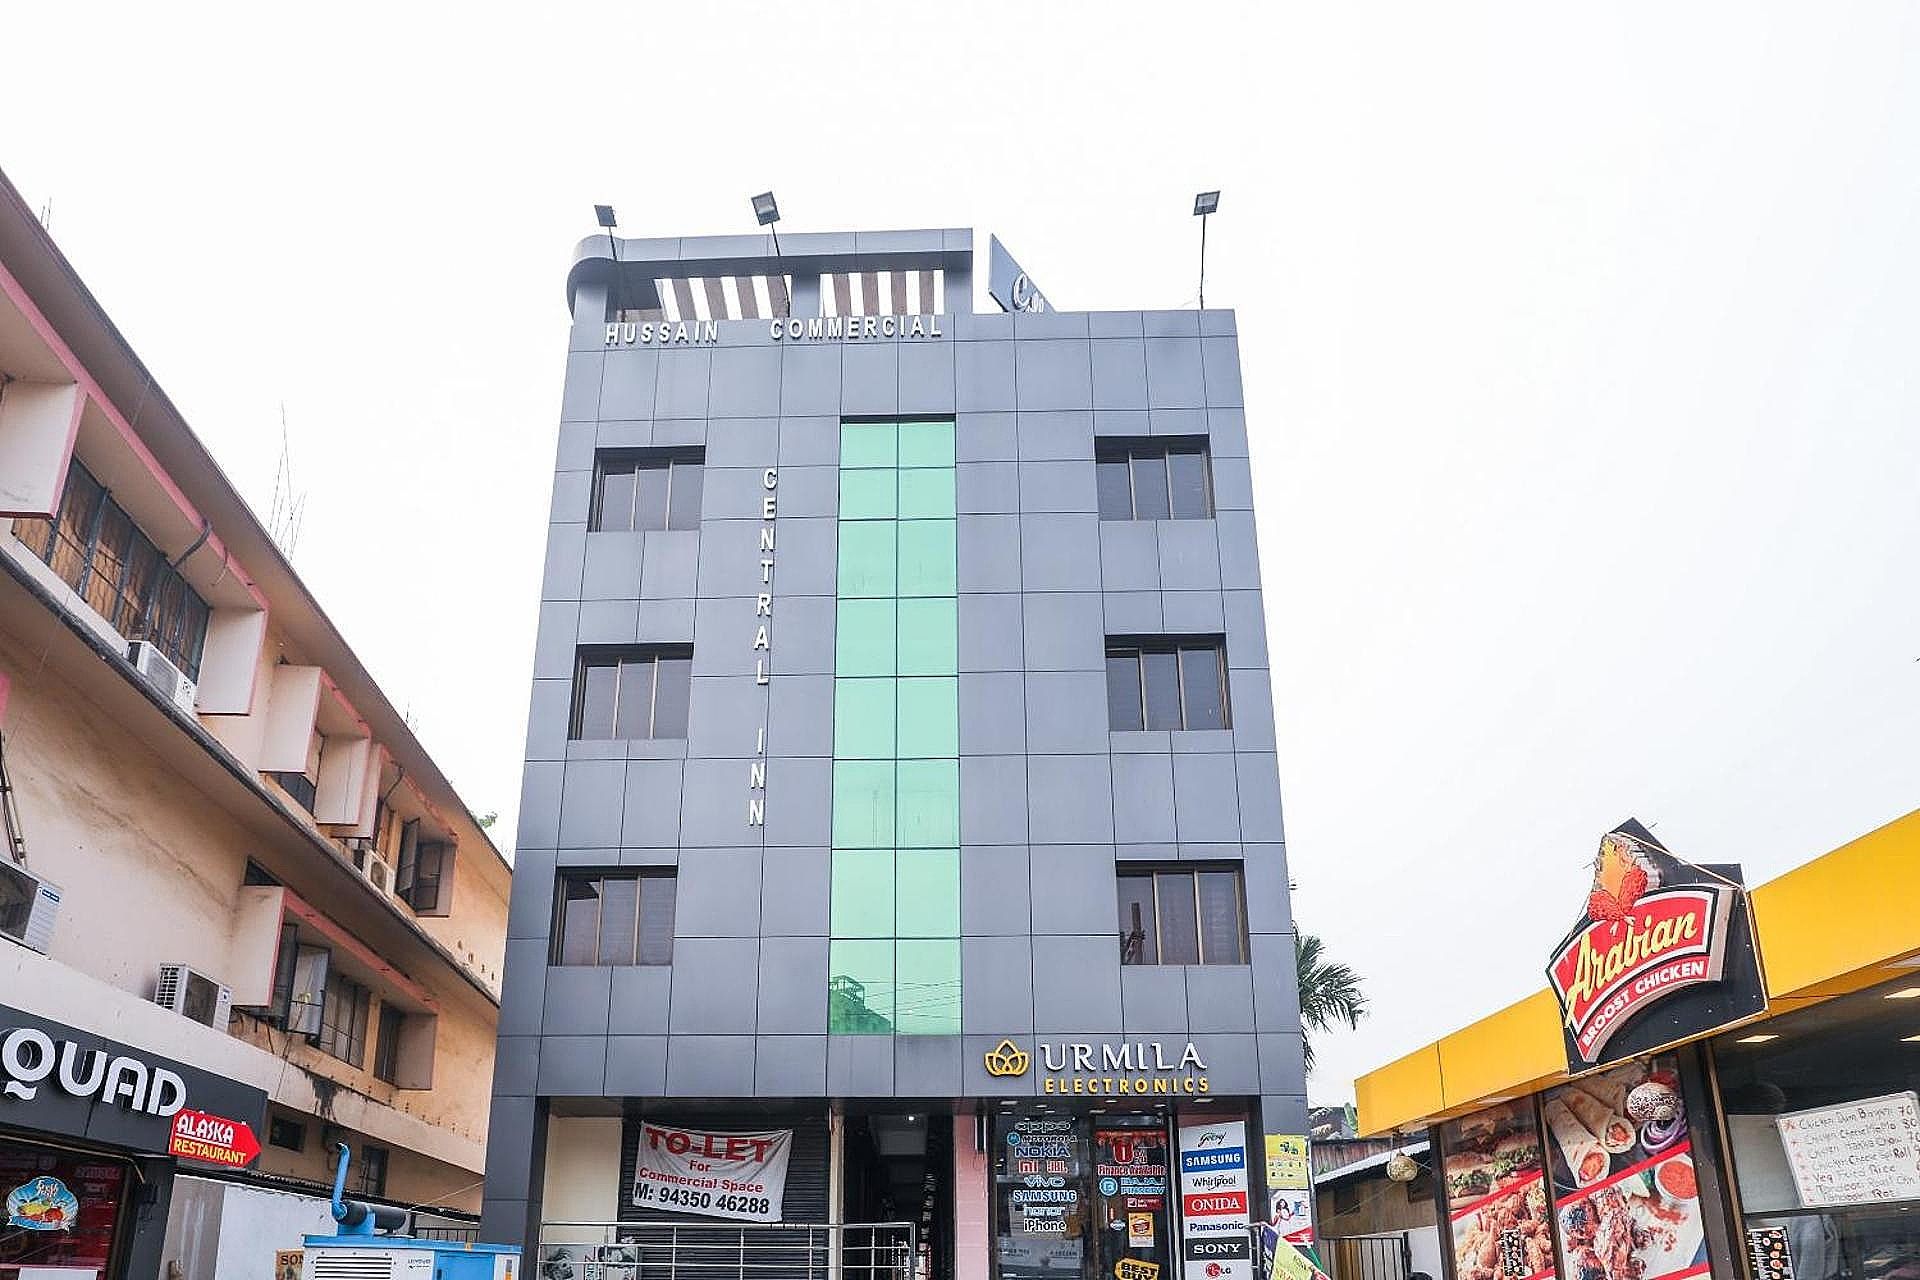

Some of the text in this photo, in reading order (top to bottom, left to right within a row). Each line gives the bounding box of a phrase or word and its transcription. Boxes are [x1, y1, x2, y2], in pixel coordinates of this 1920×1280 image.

[605, 315, 943, 345] HUSSAIN COMMERCIAL
[749, 467, 777, 826] CENTRAL INN
[1564, 911, 1698, 1029] Arabian
[1581, 960, 1705, 1047] BROOST CHICKEN
[1040, 1042, 1208, 1071] URMILA
[2, 1028, 187, 1117] QUAD
[1044, 1077, 1210, 1093] ELECTRONICS
[177, 1113, 234, 1145] ALASKA
[173, 1138, 246, 1164] RESTAURANT
[645, 1126, 774, 1162] TO-LET
[1014, 1145, 1071, 1157] NOKIA
[689, 1160, 711, 1172] For
[1186, 1153, 1241, 1167] SAMSUNG
[639, 1168, 764, 1193] Commercial Space
[1192, 1174, 1236, 1190] Whirlpool
[634, 1182, 770, 1214] M: 94350 46288
[1013, 1190, 1078, 1202] SAMSUNG
[1191, 1197, 1241, 1211] ONIDA
[1023, 1218, 1067, 1232] iPhone
[1189, 1220, 1244, 1231] Panasonic
[1193, 1243, 1242, 1254] SONY
